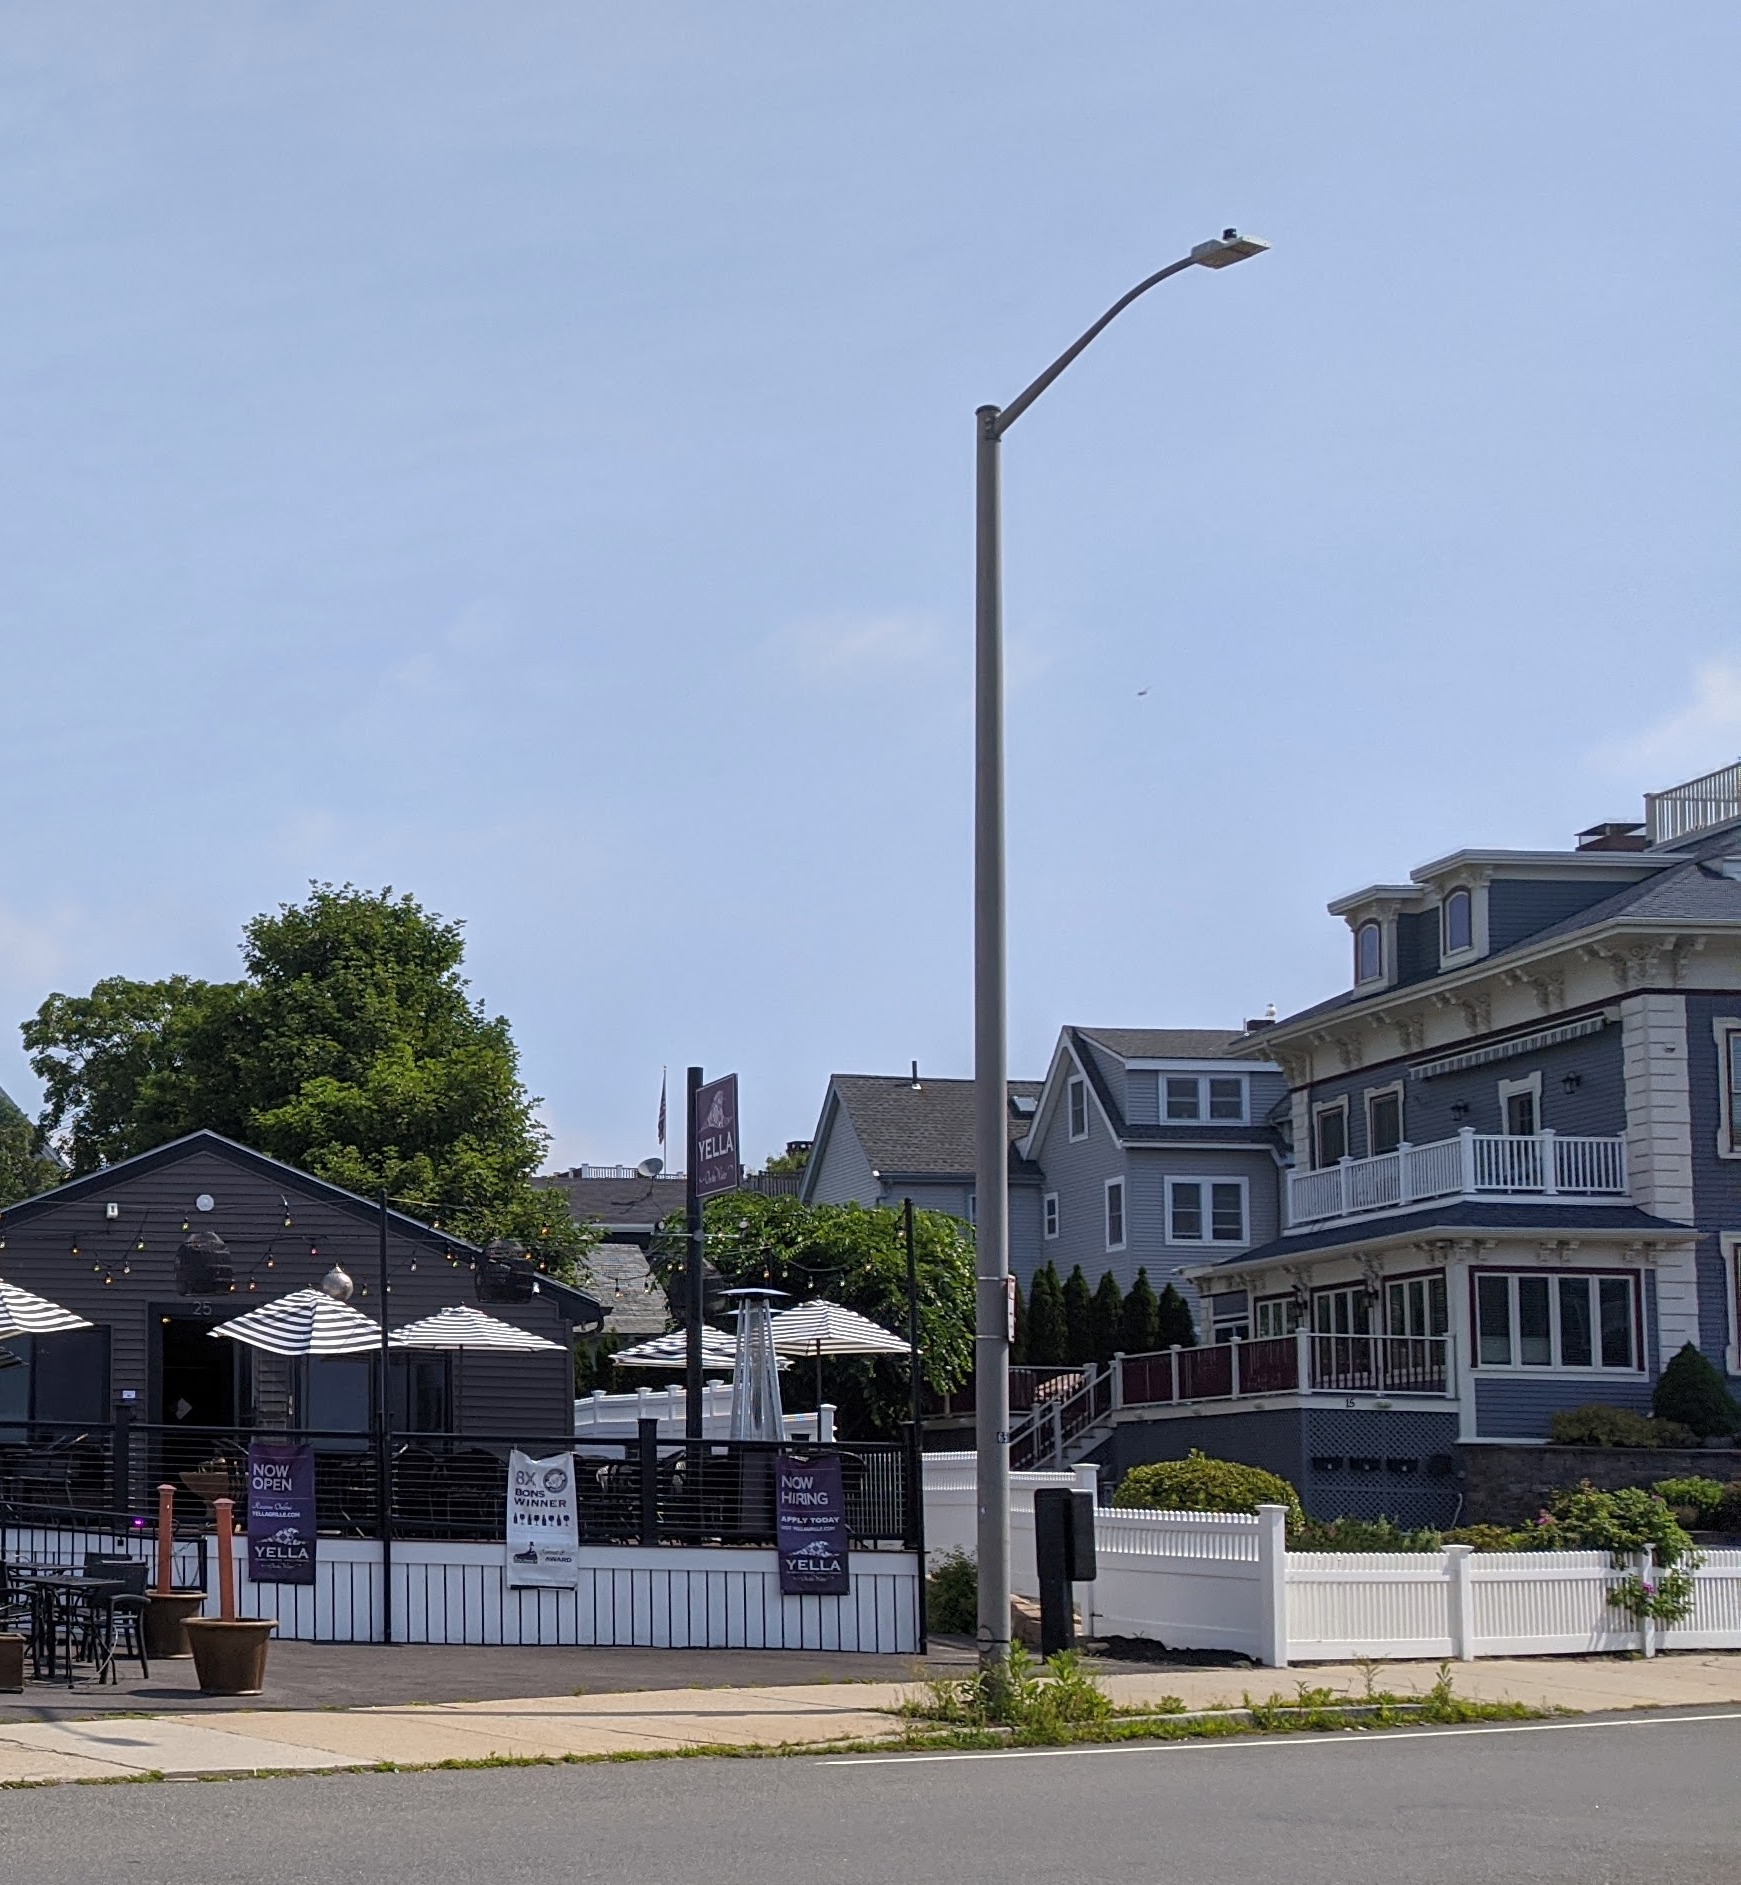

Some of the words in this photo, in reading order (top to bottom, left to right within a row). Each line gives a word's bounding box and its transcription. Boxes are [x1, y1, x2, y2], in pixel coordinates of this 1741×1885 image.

[698, 1131, 734, 1162] YELLA
[192, 1301, 212, 1316] 25
[253, 1463, 290, 1478] NOW
[252, 1477, 293, 1491] OPEN
[516, 1470, 536, 1488] 8X
[781, 1475, 814, 1490] NOW
[515, 1488, 545, 1498] BONS
[781, 1491, 829, 1505] HIRING
[513, 1497, 567, 1508] WINNER
[781, 1516, 808, 1524] APPLY
[810, 1516, 840, 1524] TODAY
[254, 1546, 309, 1559] YELLA
[786, 1559, 841, 1571] YELLA
